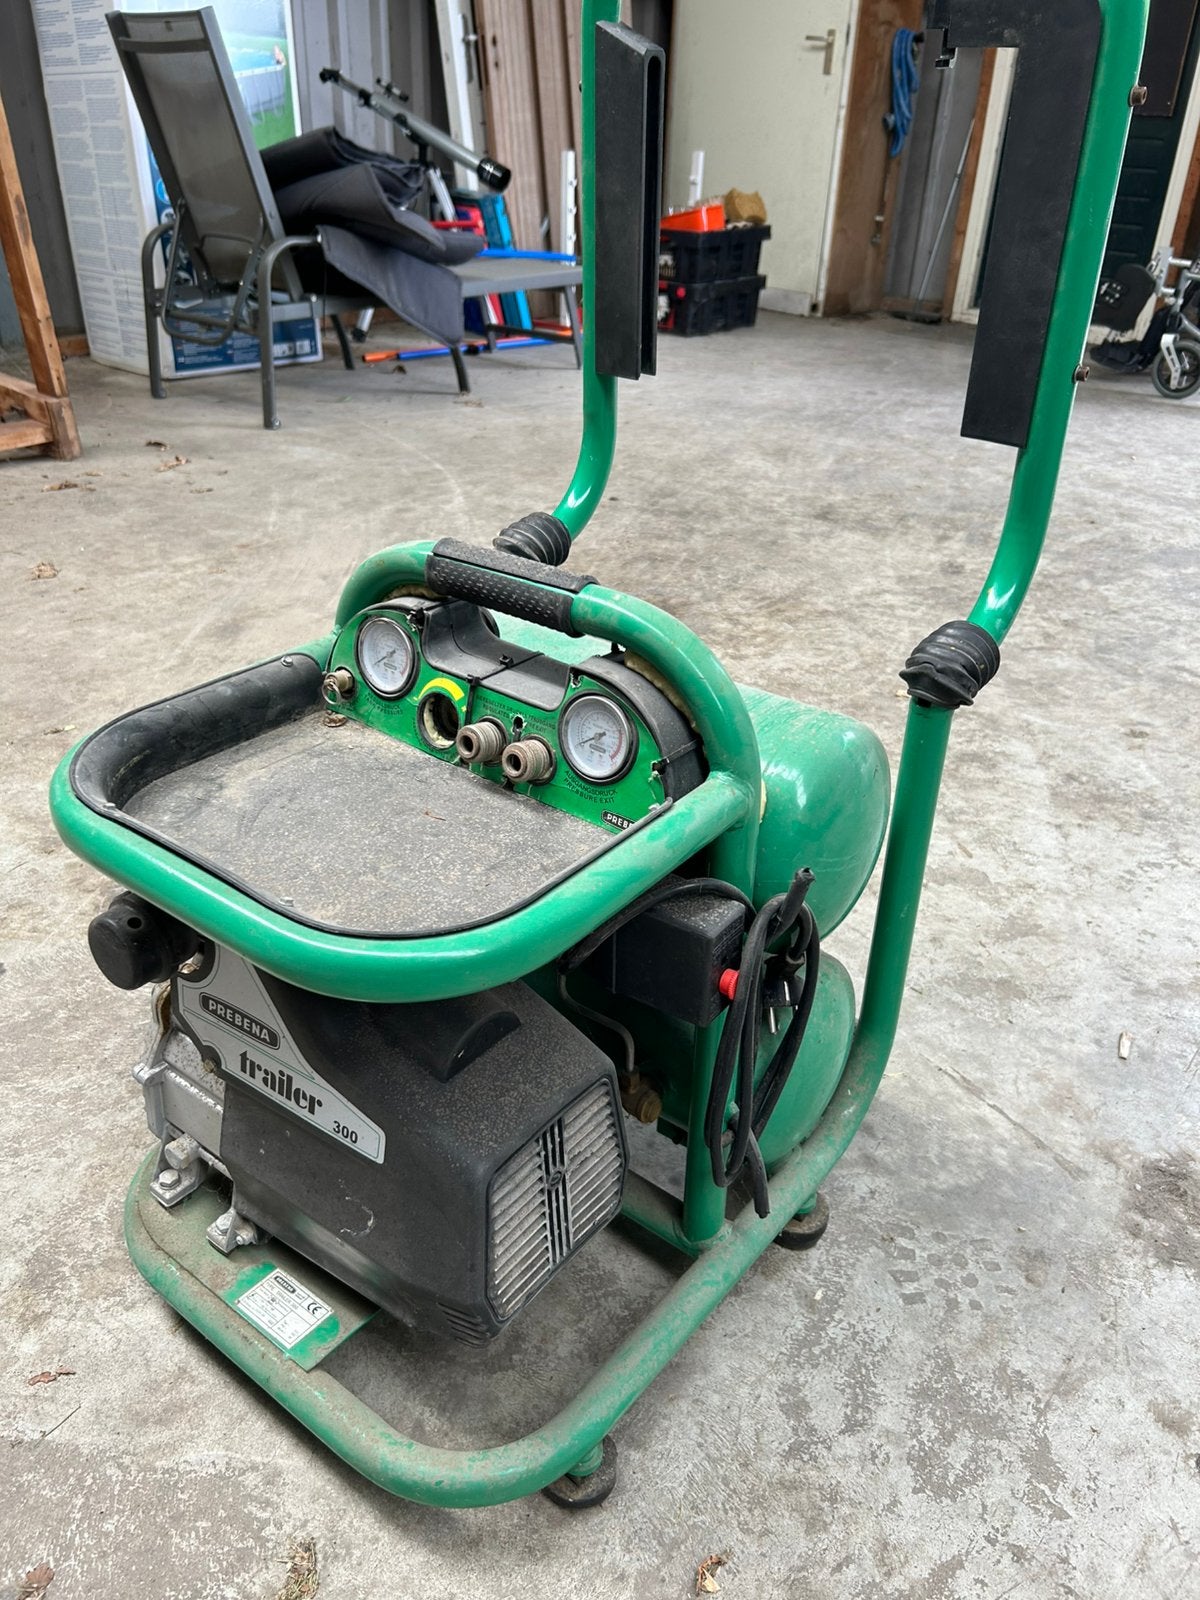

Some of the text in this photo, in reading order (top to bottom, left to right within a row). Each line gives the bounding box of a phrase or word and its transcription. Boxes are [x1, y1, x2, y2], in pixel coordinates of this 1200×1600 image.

[606, 813, 634, 829] PREB
[208, 999, 271, 1043] PREBENA
[239, 1050, 358, 1144] trailer 300
